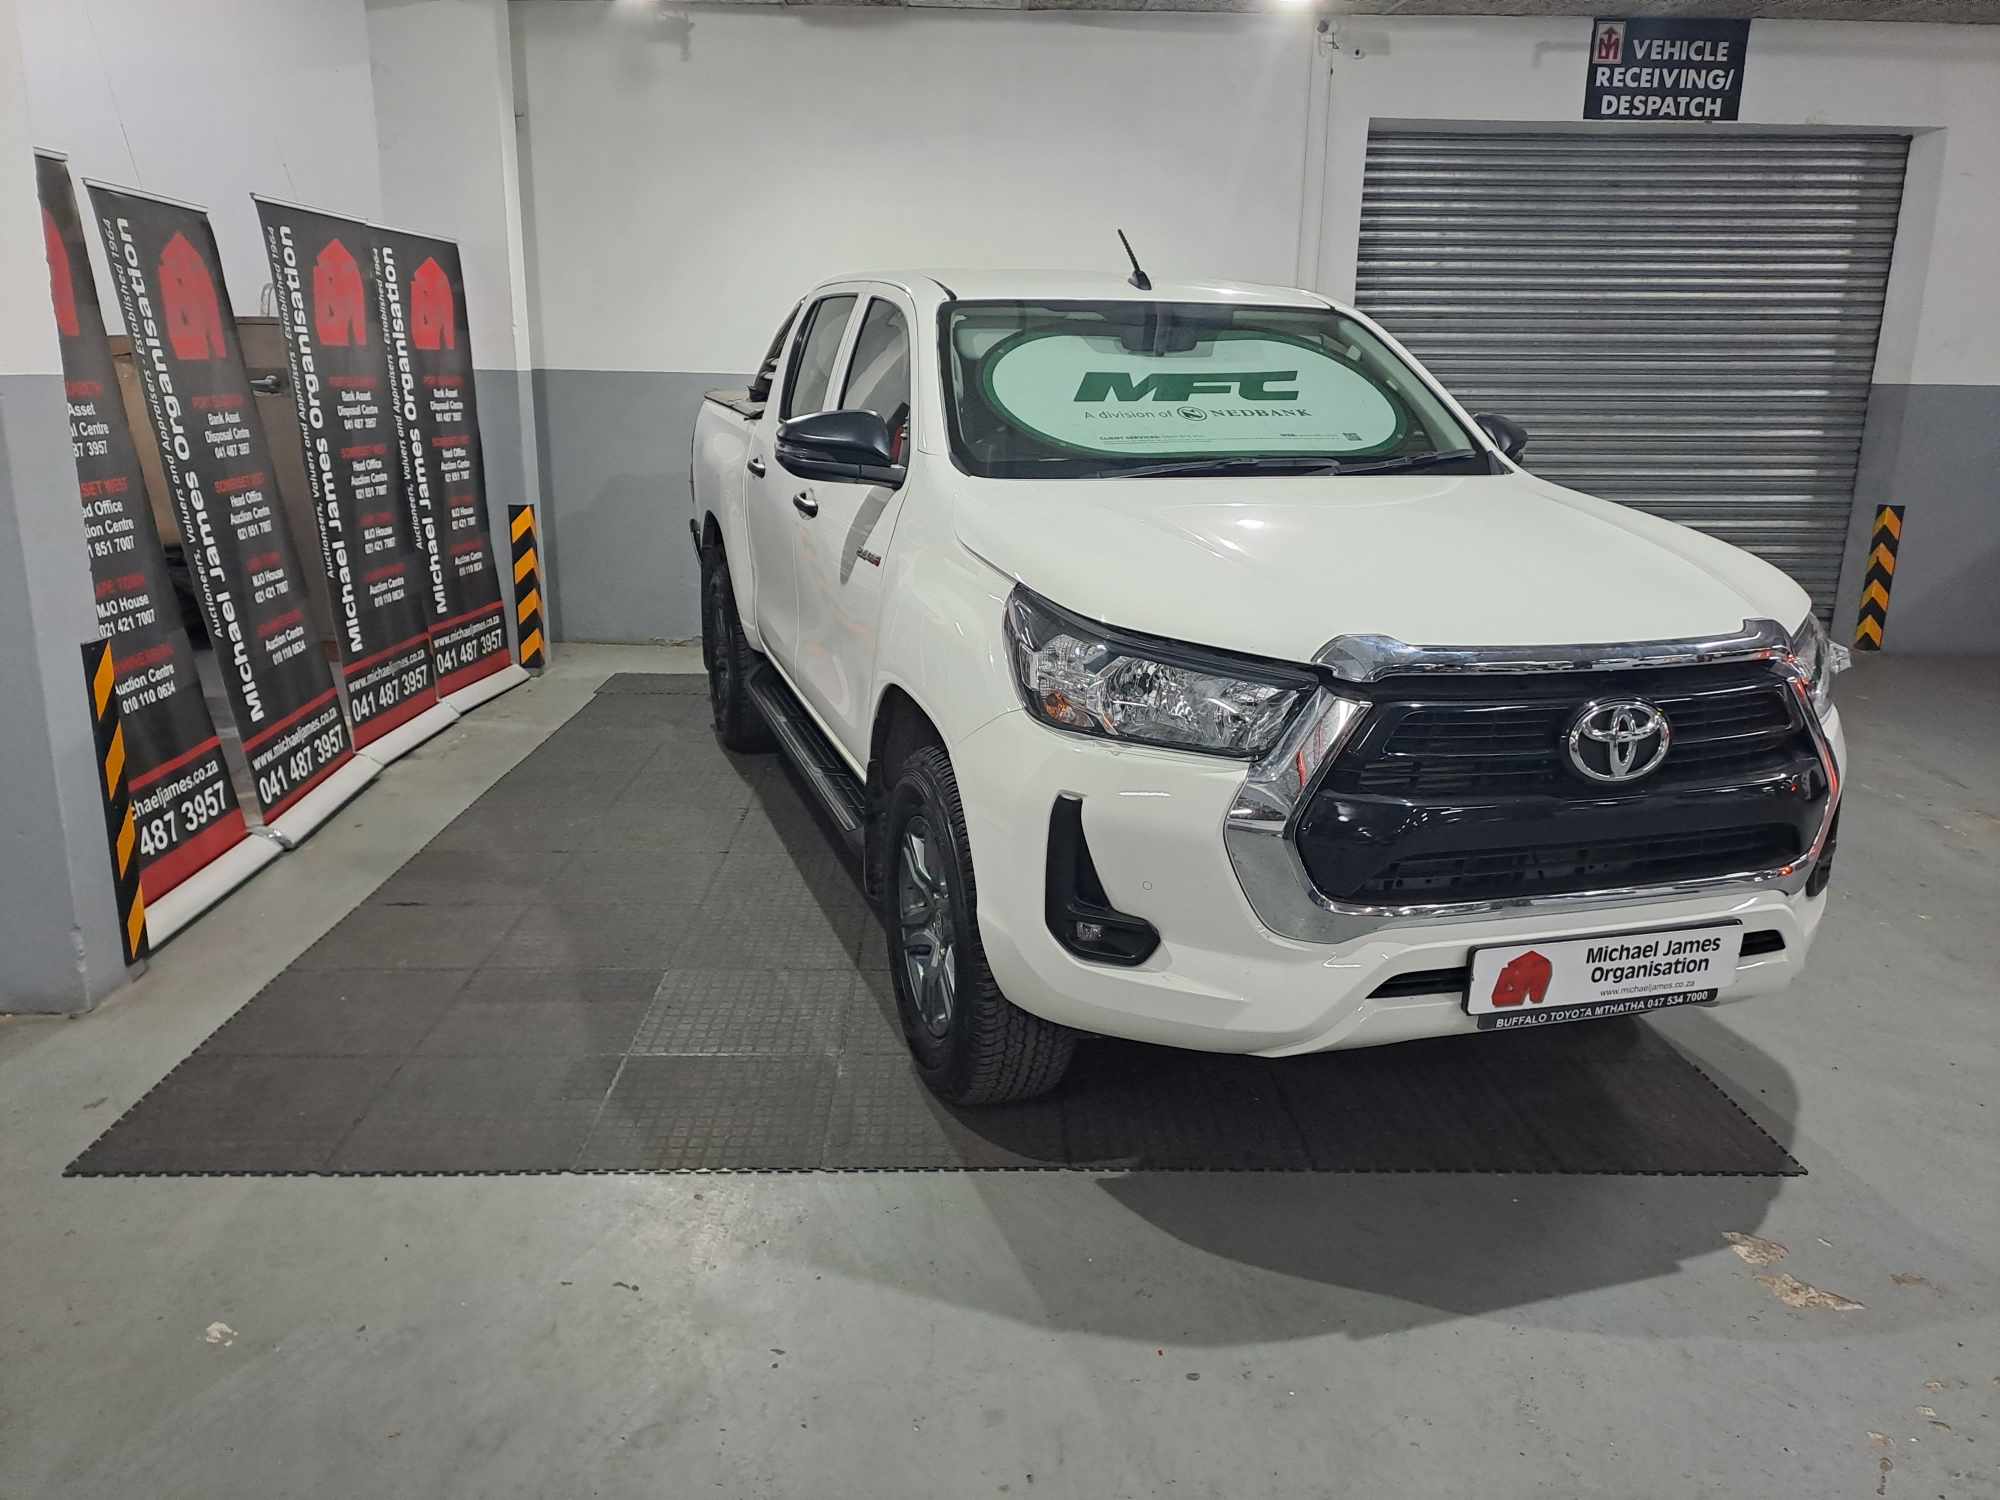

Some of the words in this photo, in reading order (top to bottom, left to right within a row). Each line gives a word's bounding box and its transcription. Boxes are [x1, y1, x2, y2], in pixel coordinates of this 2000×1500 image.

[1633, 39, 1730, 62] VEHICLE
[1595, 66, 1736, 91] RECEIVING/
[1600, 94, 1723, 118] DESPATCH
[116, 217, 190, 461] Organisation
[279, 225, 324, 429] Organisation
[382, 246, 417, 421] Organisation
[1073, 370, 1299, 402] MFC
[79, 421, 109, 436] Centre
[1099, 410, 1155, 419] division
[1210, 408, 1313, 417] NEDBANK
[72, 442, 84, 457] 87
[164, 454, 180, 484] and
[316, 437, 342, 533] James
[410, 428, 431, 511] James
[94, 500, 123, 516] Office
[105, 518, 134, 534] Centre
[185, 471, 226, 583] James
[95, 540, 113, 557] 851
[421, 517, 448, 614] Michael
[119, 593, 149, 614] House
[331, 540, 364, 653] Michael
[117, 616, 136, 633] 421
[216, 591, 265, 723] Michael
[436, 647, 458, 674] 041
[460, 640, 478, 663] 487
[481, 628, 502, 654] 3957
[352, 691, 376, 722] 041
[379, 678, 399, 707] 487
[401, 664, 427, 695] 3957
[259, 765, 288, 804] 041
[290, 746, 313, 781] 487
[314, 723, 344, 764] 3957
[132, 760, 219, 820] haeljames.co.za
[140, 810, 178, 856] 487
[181, 780, 227, 831] 3957
[1586, 940, 1660, 965] Michael
[1663, 935, 1722, 957] James
[1591, 956, 1710, 984] Organisation
[1495, 1013, 1547, 1028] BUFFALO
[1550, 1007, 1593, 1021] TOYOTA
[1594, 1001, 1645, 1016] MTHATHA
[1666, 995, 1683, 1006] 534
[1686, 991, 1708, 1003] 7000
